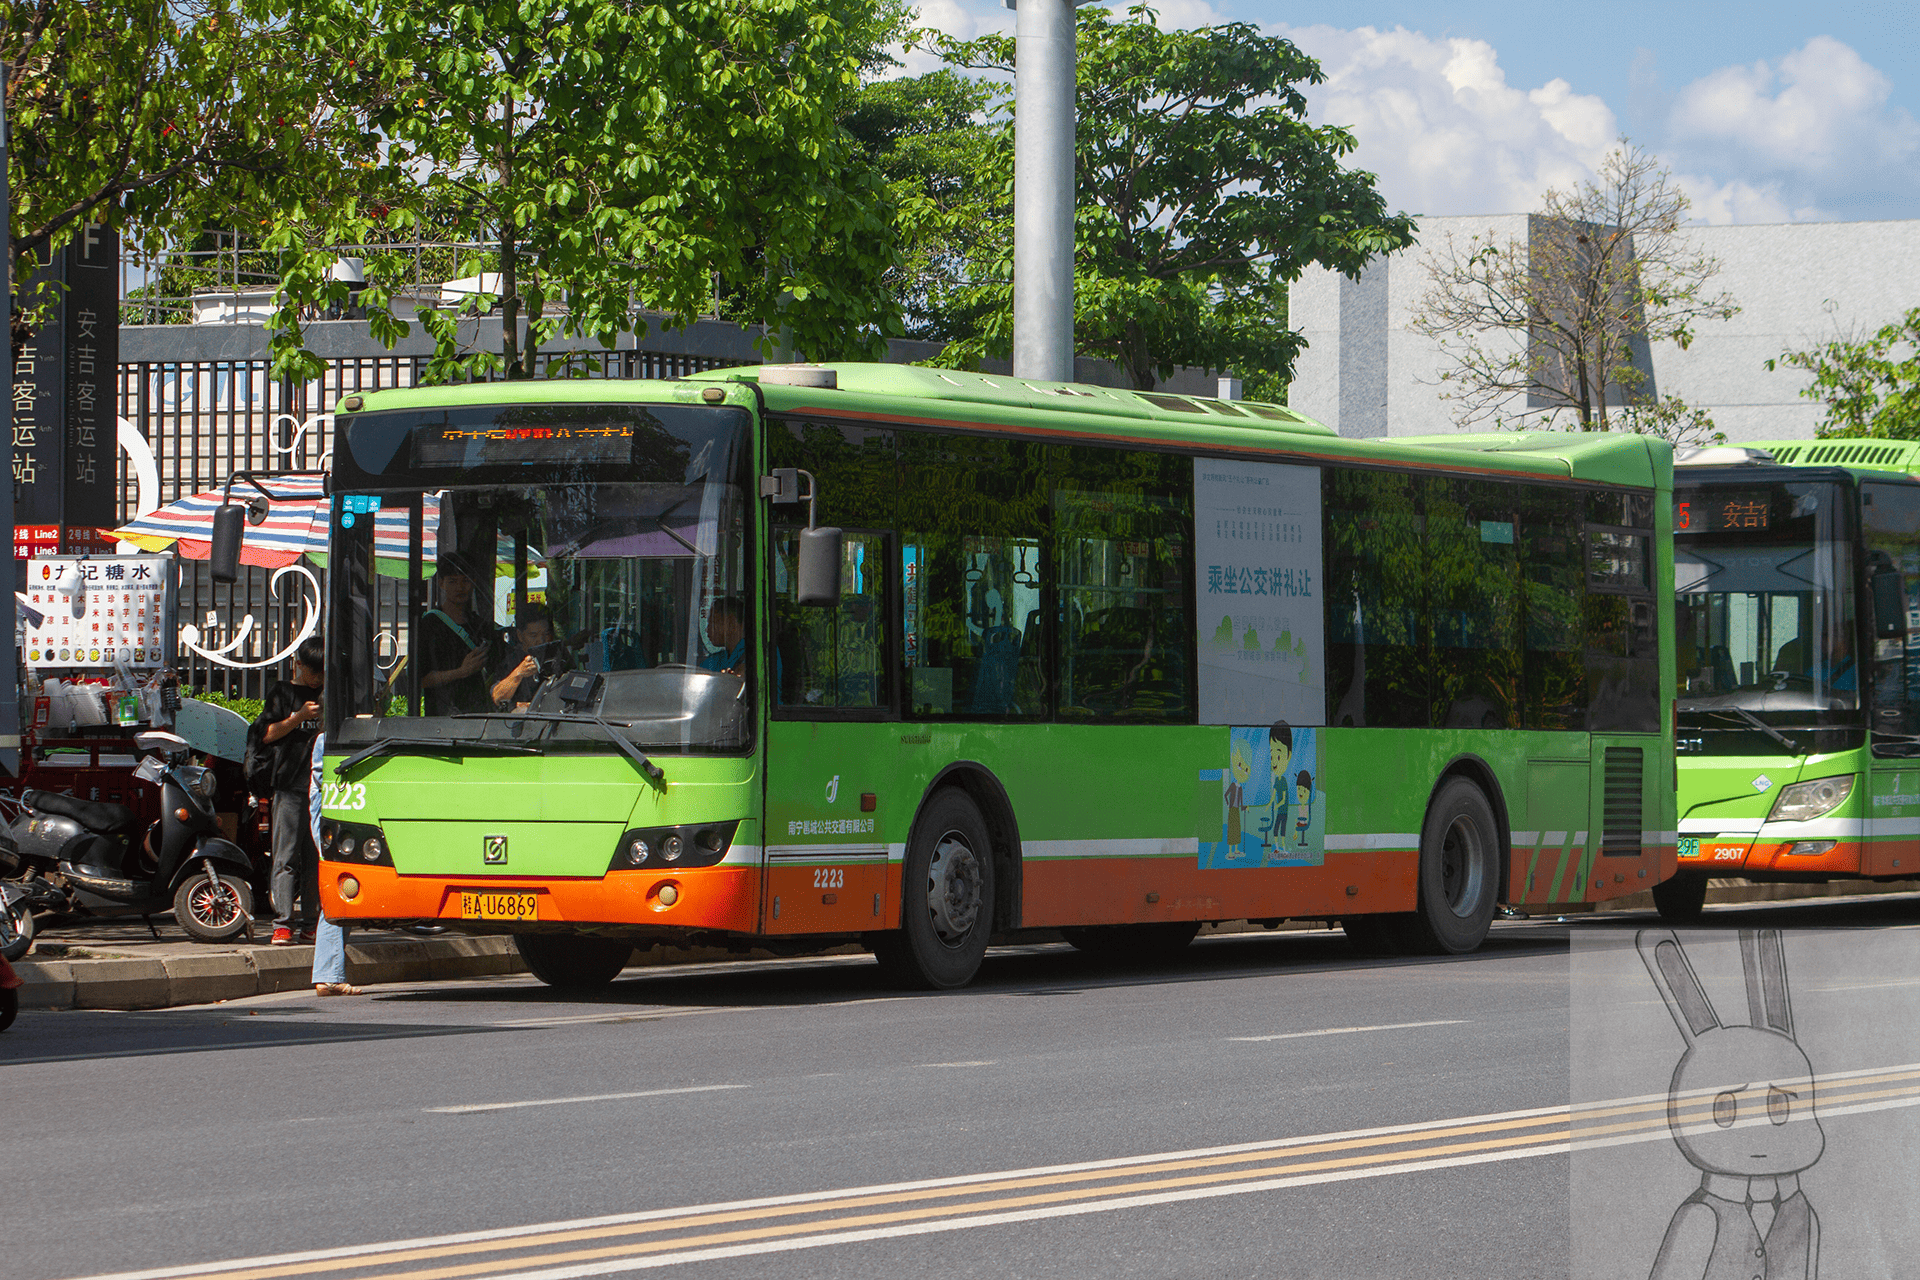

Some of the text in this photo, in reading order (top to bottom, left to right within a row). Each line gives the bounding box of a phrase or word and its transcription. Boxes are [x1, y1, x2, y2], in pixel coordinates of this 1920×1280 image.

[84, 222, 101, 259] F
[76, 308, 97, 484] 安吉客运站
[35, 529, 58, 539] Line2
[69, 529, 90, 540] 2号线
[35, 546, 57, 555] Line3
[69, 546, 90, 555] 3号线
[1208, 565, 1312, 597] 乘坐公交讲礼让
[322, 783, 366, 810] 2223
[1714, 848, 1744, 860] 2907
[813, 868, 844, 888] 2223
